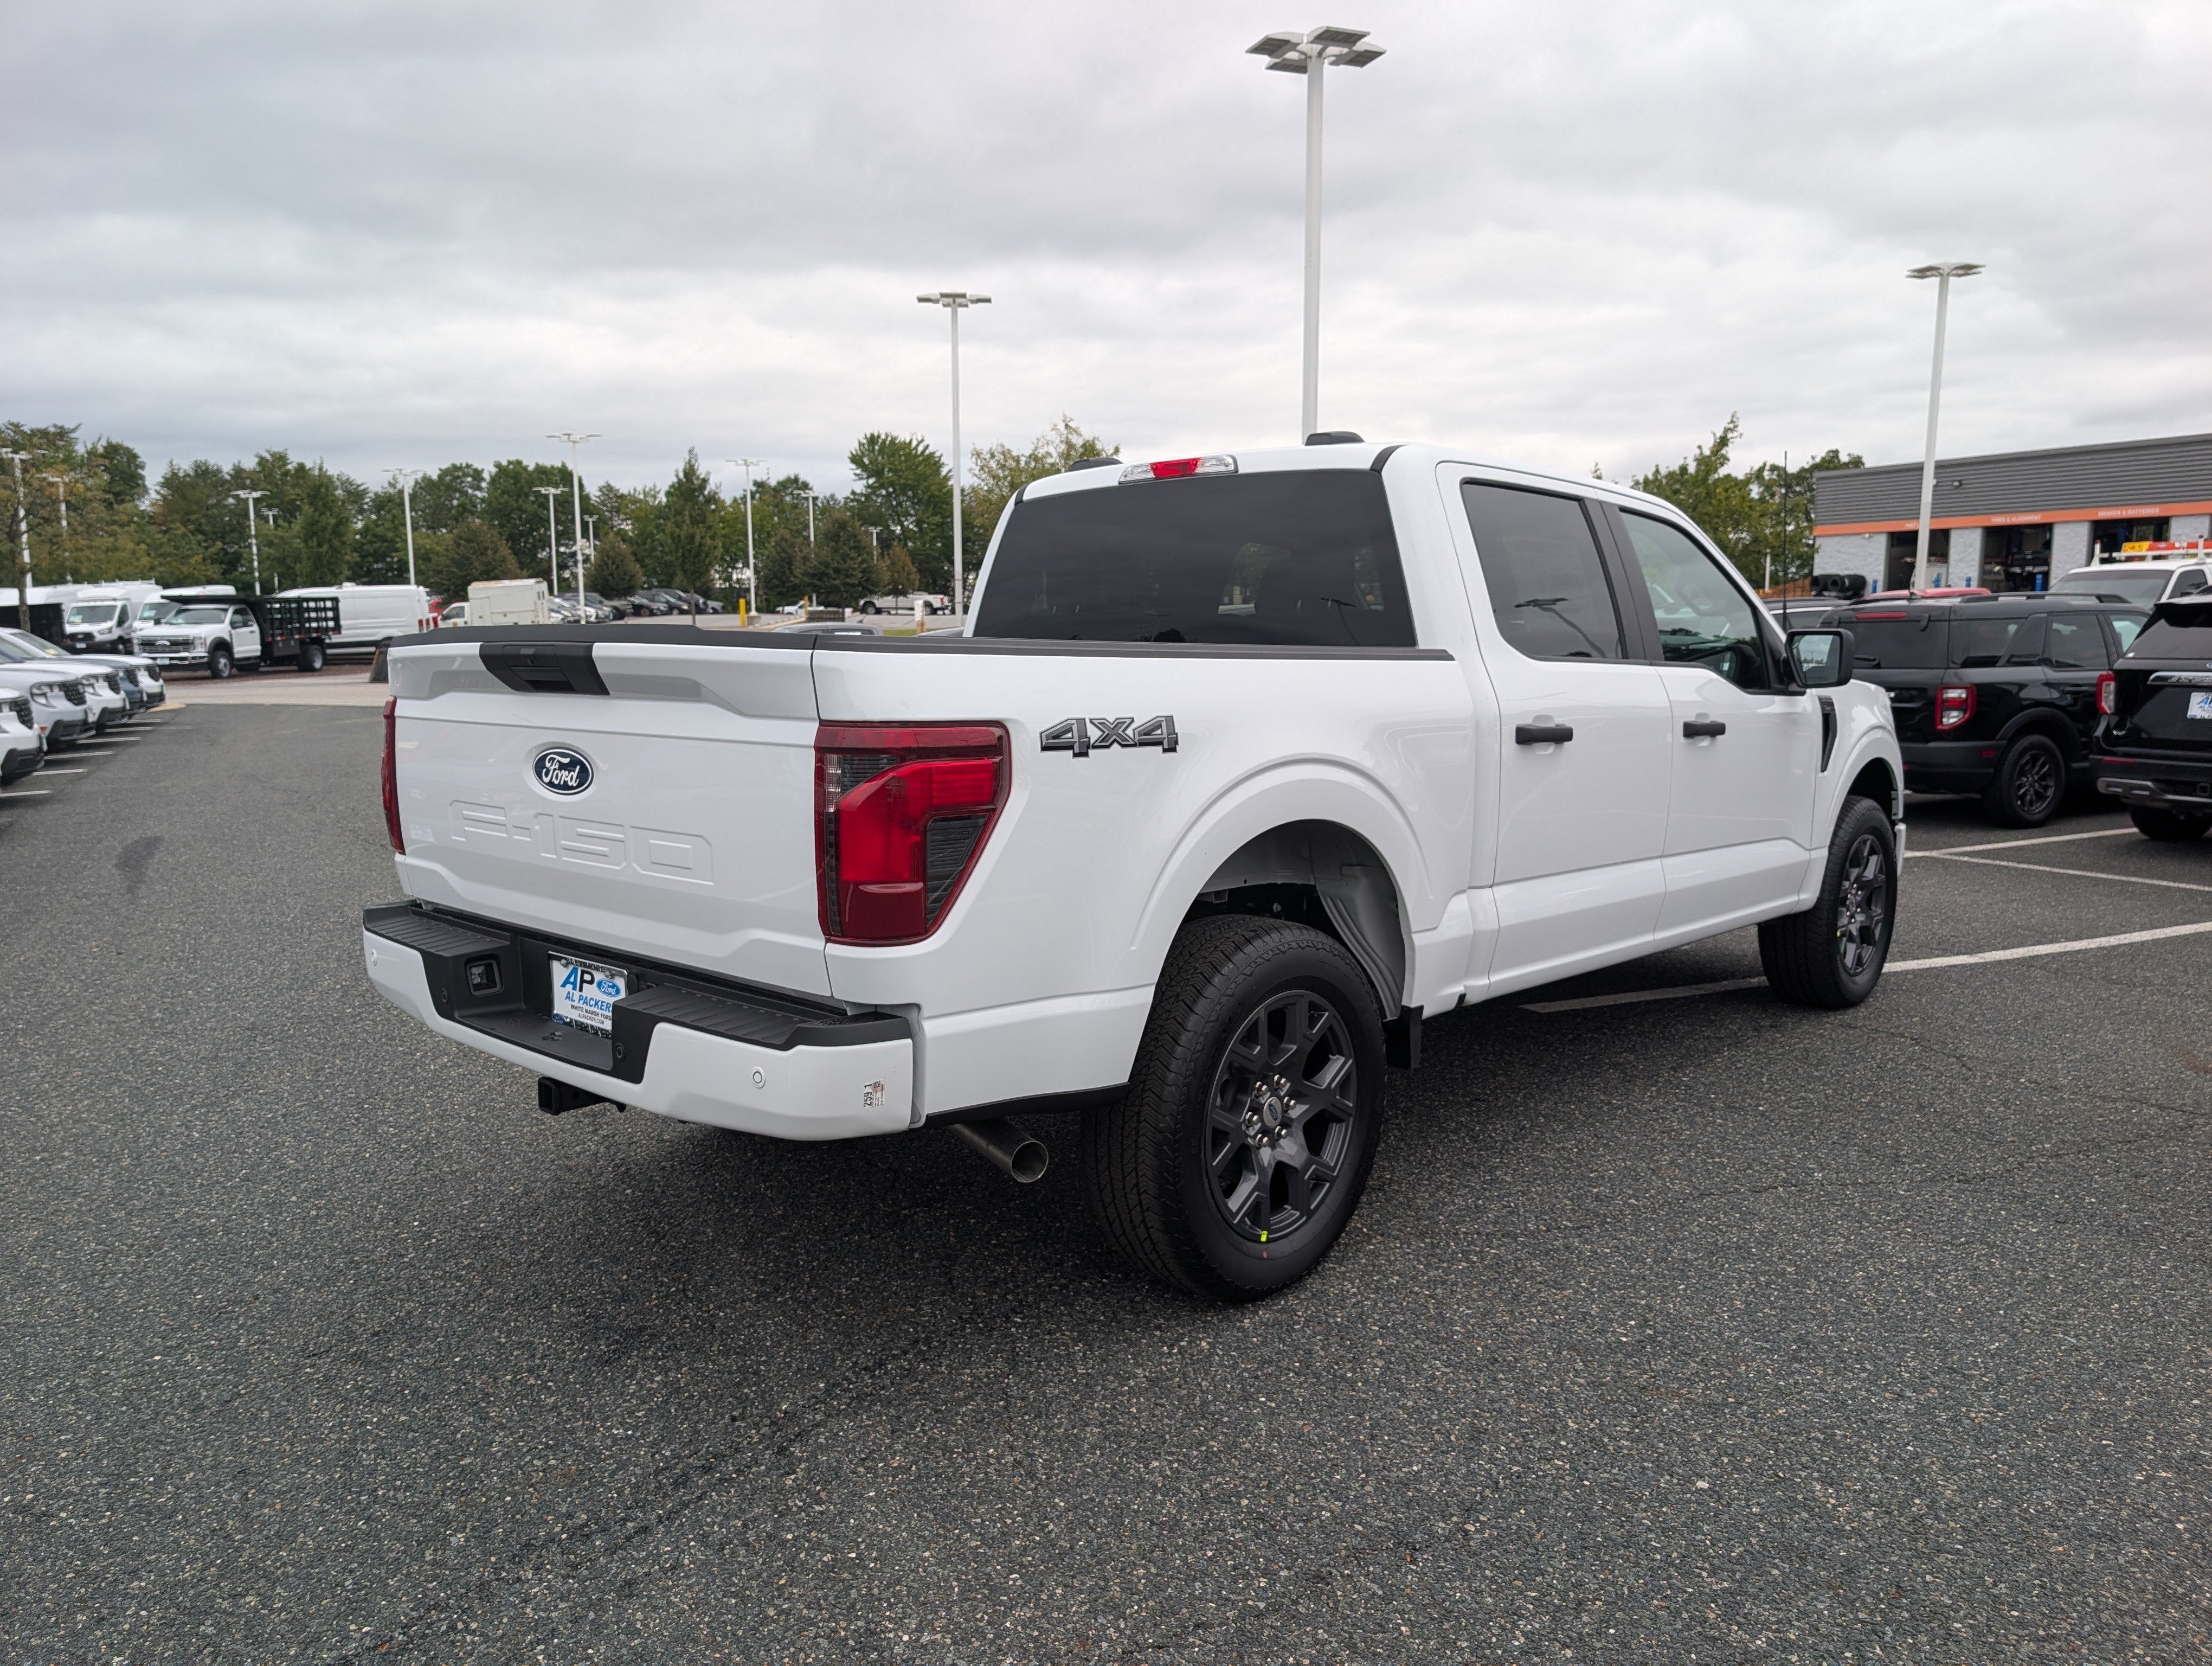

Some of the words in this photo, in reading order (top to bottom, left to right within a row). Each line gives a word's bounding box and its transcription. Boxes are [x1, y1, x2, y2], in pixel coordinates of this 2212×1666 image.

[543, 754, 580, 787] Ford
[449, 799, 715, 886] F-150
[560, 966, 595, 992] AP
[601, 981, 617, 995] Ford
[565, 991, 575, 1002] AL
[570, 1004, 584, 1013] WHITE
[585, 1008, 600, 1017] MARSH
[600, 1013, 612, 1021] FORD
